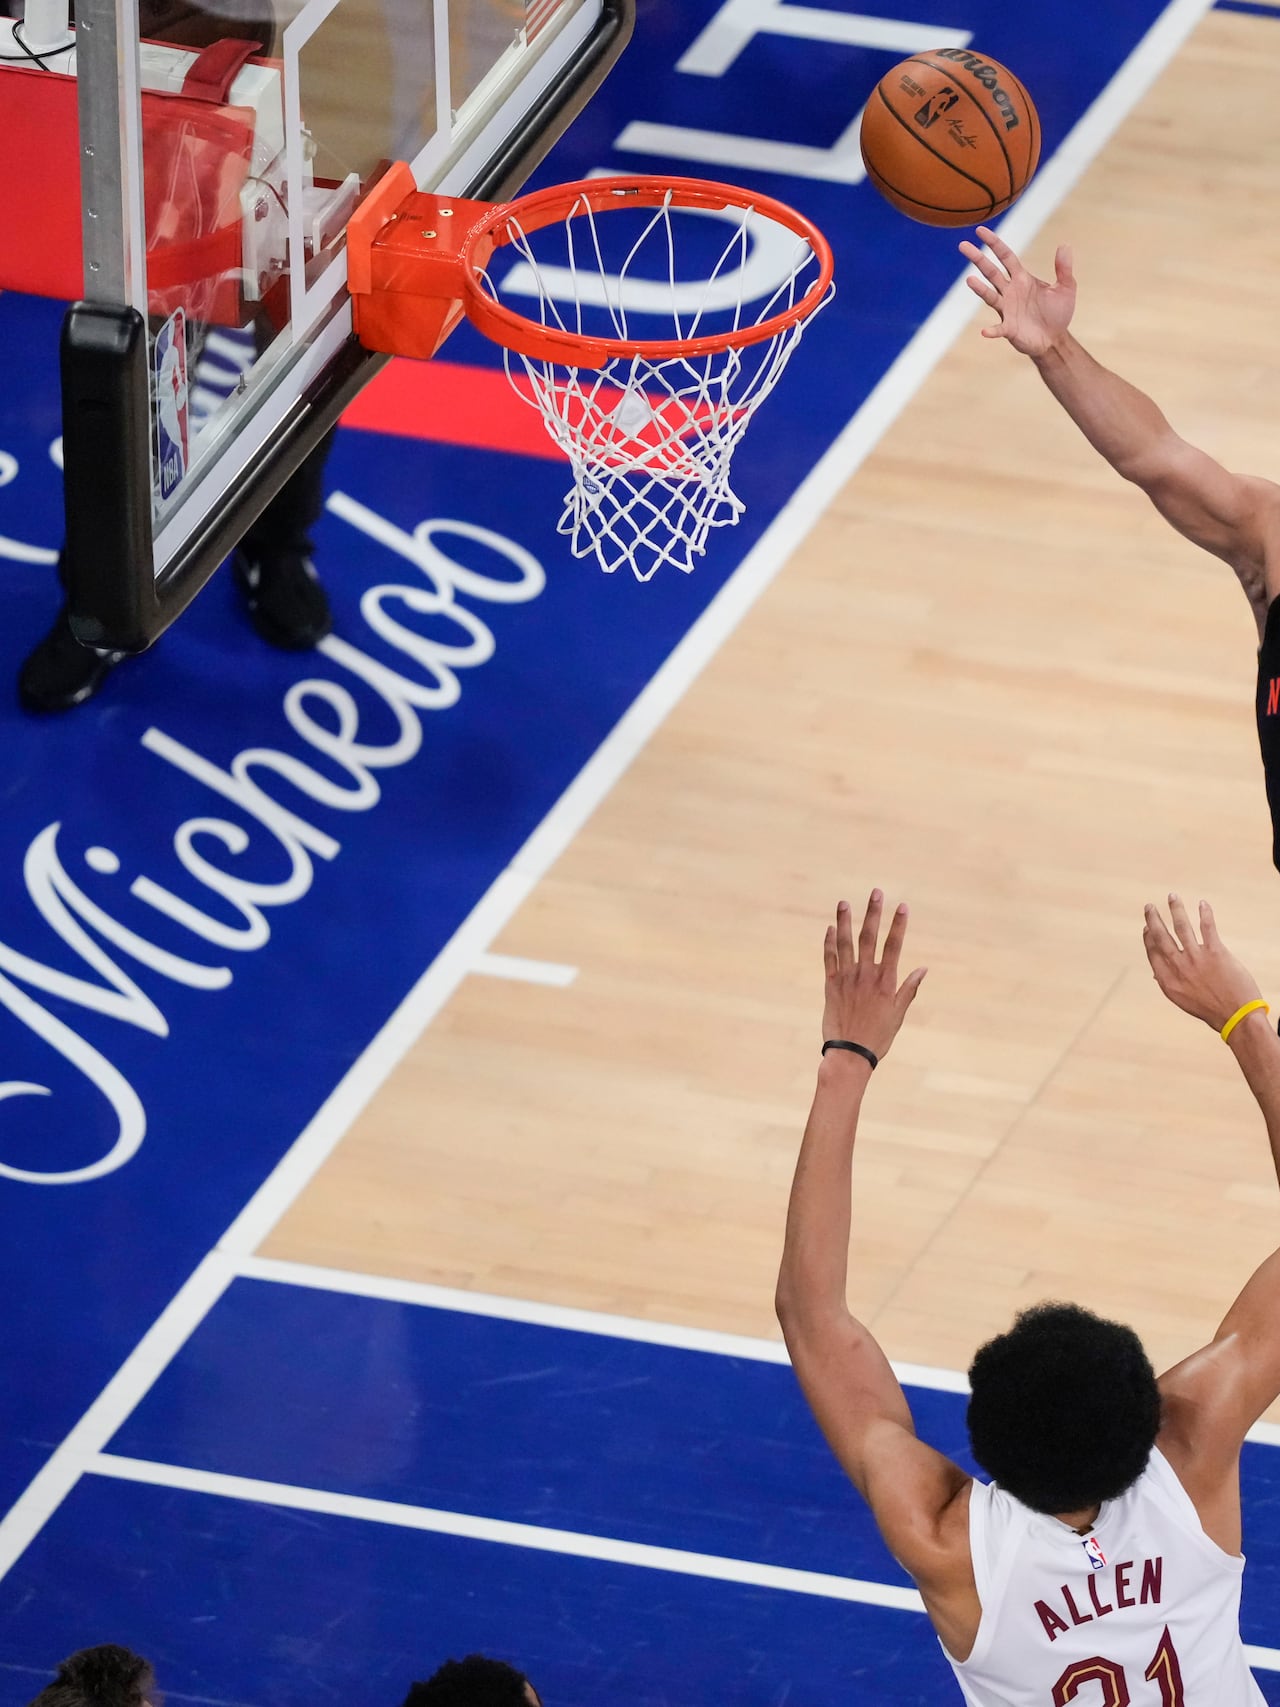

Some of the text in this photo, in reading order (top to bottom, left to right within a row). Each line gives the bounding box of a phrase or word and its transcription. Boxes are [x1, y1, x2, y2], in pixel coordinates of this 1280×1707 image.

[935, 48, 1020, 132] Wilson
[163, 451, 179, 493] NBA
[0, 490, 547, 1184] Michelob
[1033, 1556, 1163, 1643] ALLEN
